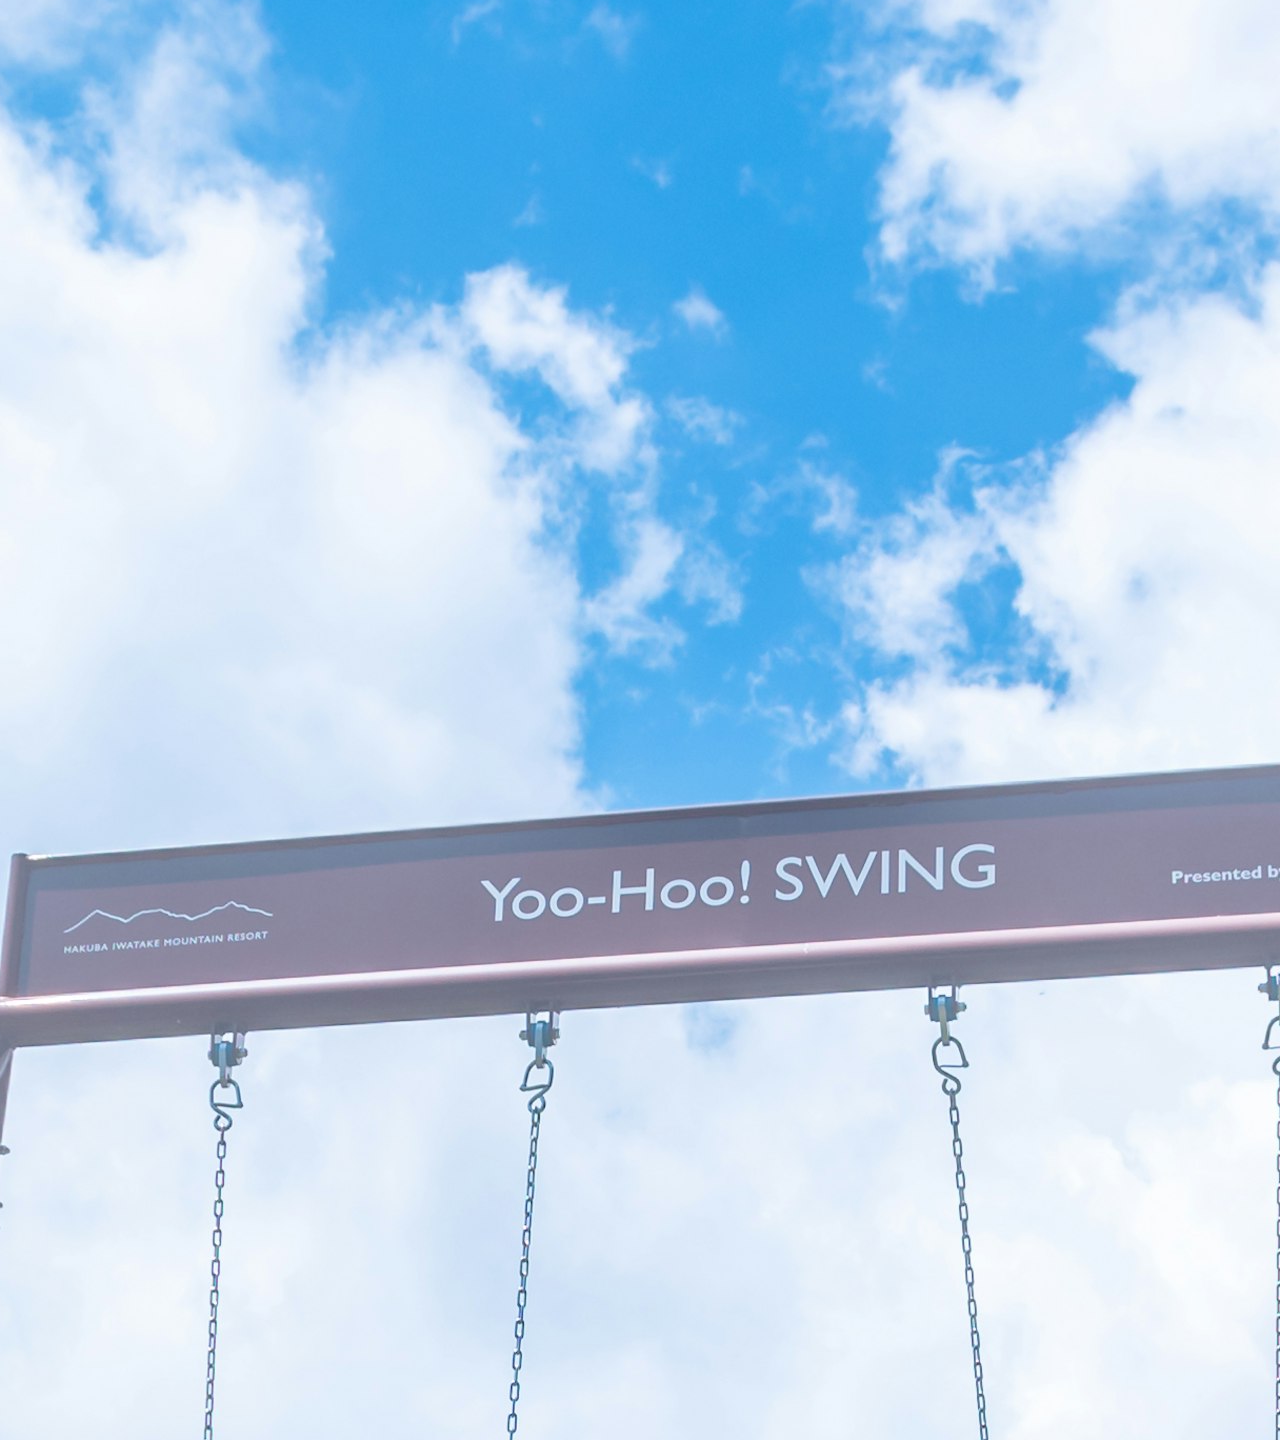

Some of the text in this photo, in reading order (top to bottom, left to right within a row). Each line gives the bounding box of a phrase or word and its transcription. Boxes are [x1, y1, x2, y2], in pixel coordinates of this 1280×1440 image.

[480, 843, 996, 922] Yoo-Hoo! SWING
[1171, 865, 1262, 884] Presented
[63, 930, 268, 954] HAKUBA IWATAKE MOUNTAIN RESORT
